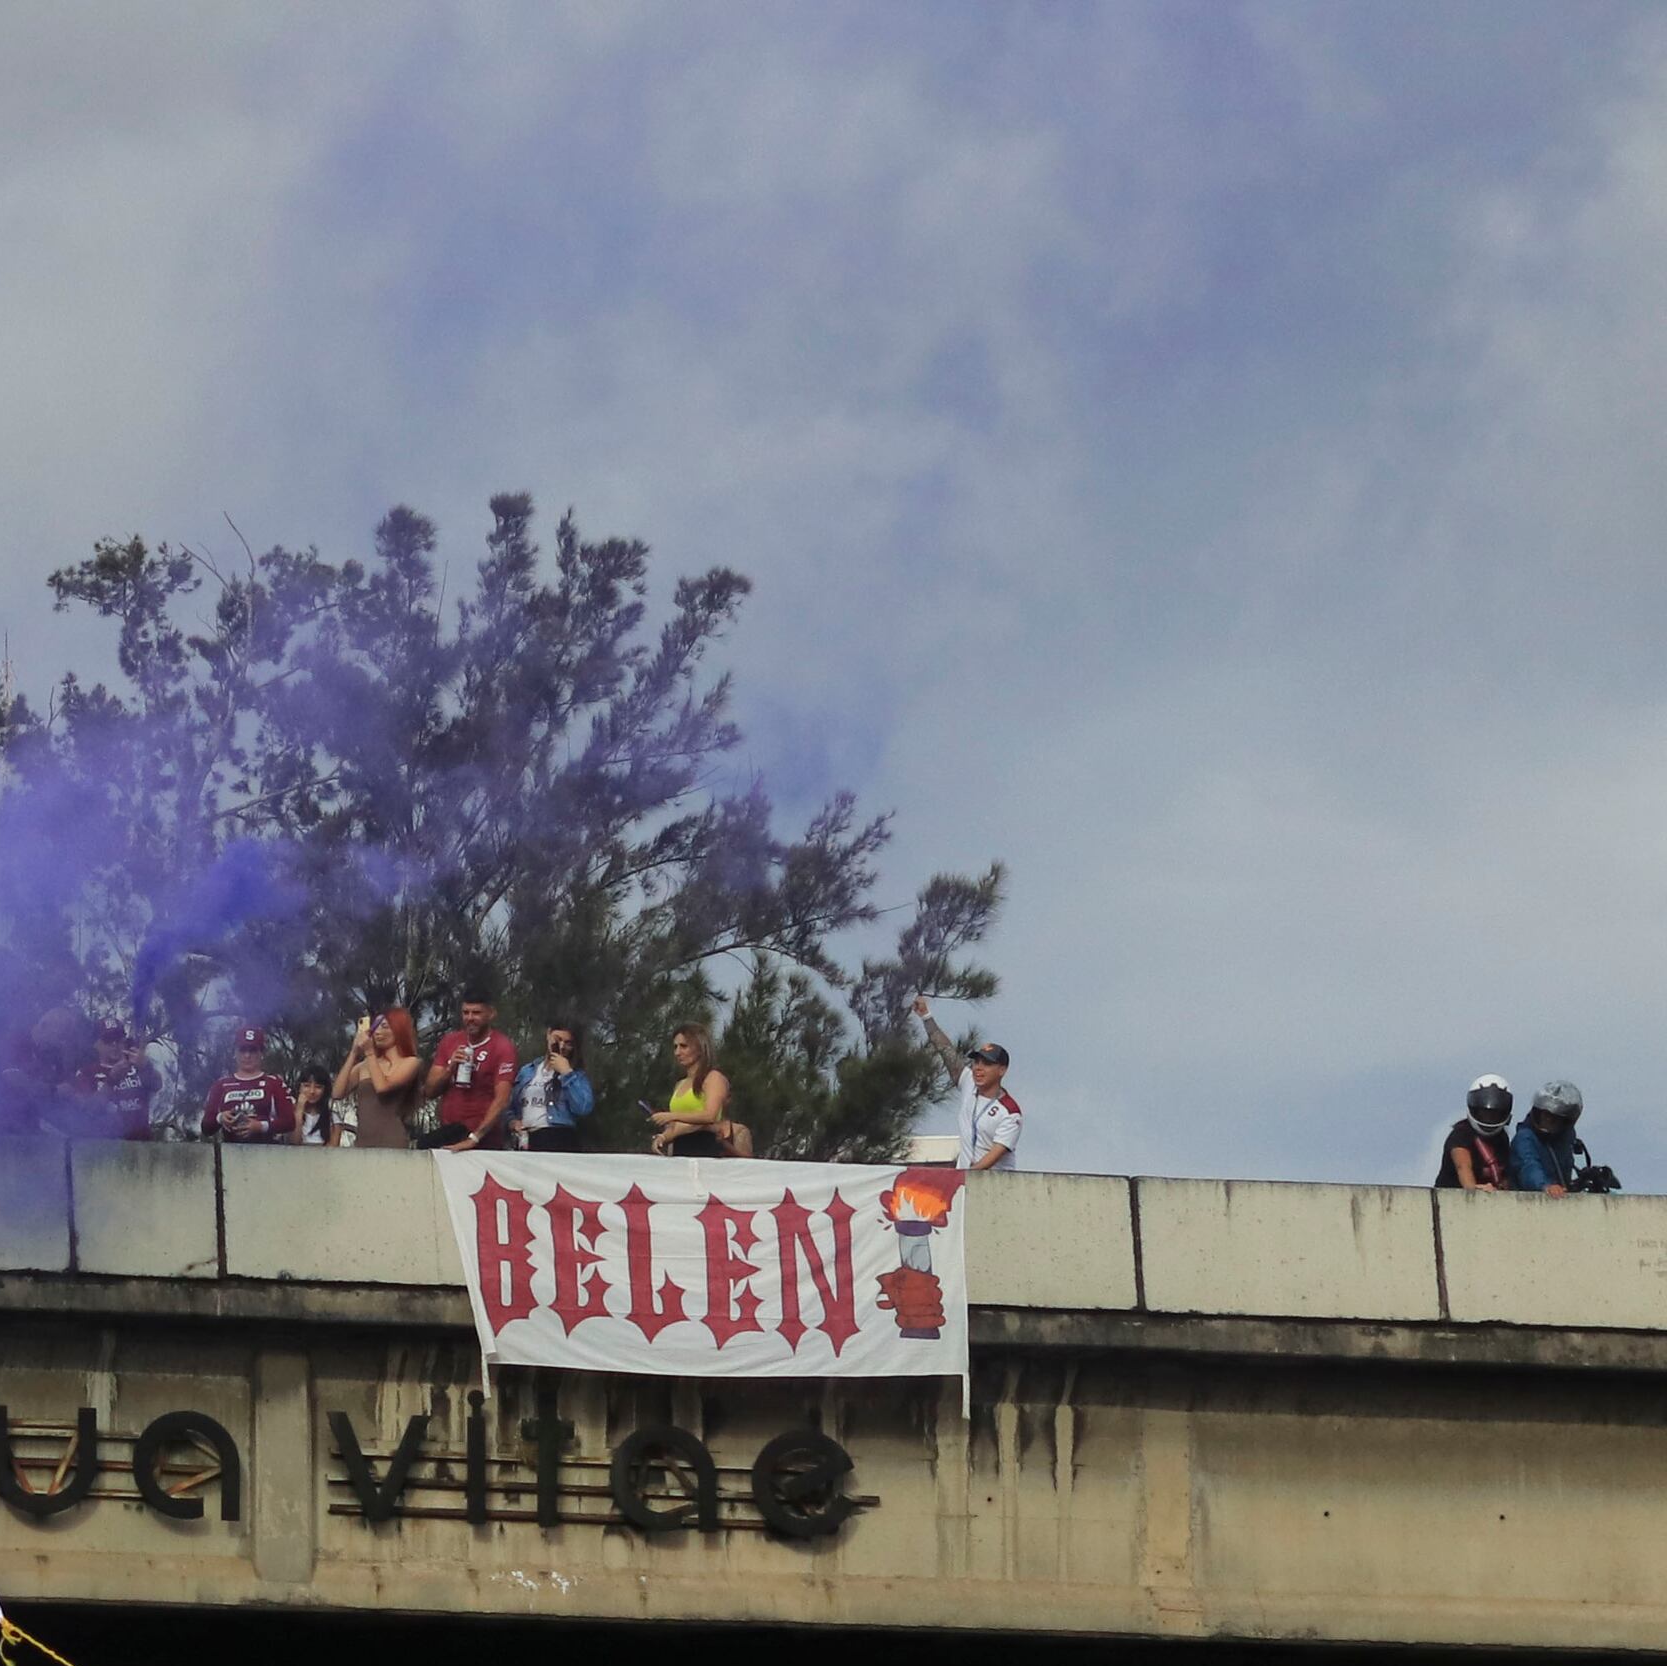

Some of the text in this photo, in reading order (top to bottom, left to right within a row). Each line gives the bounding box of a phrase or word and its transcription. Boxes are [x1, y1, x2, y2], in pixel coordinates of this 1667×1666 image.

[245, 1030, 255, 1041] S
[477, 1050, 488, 1062] S
[988, 1105, 999, 1117] S
[470, 1170, 861, 1358] BELEN
[328, 1388, 858, 1540] vitae
